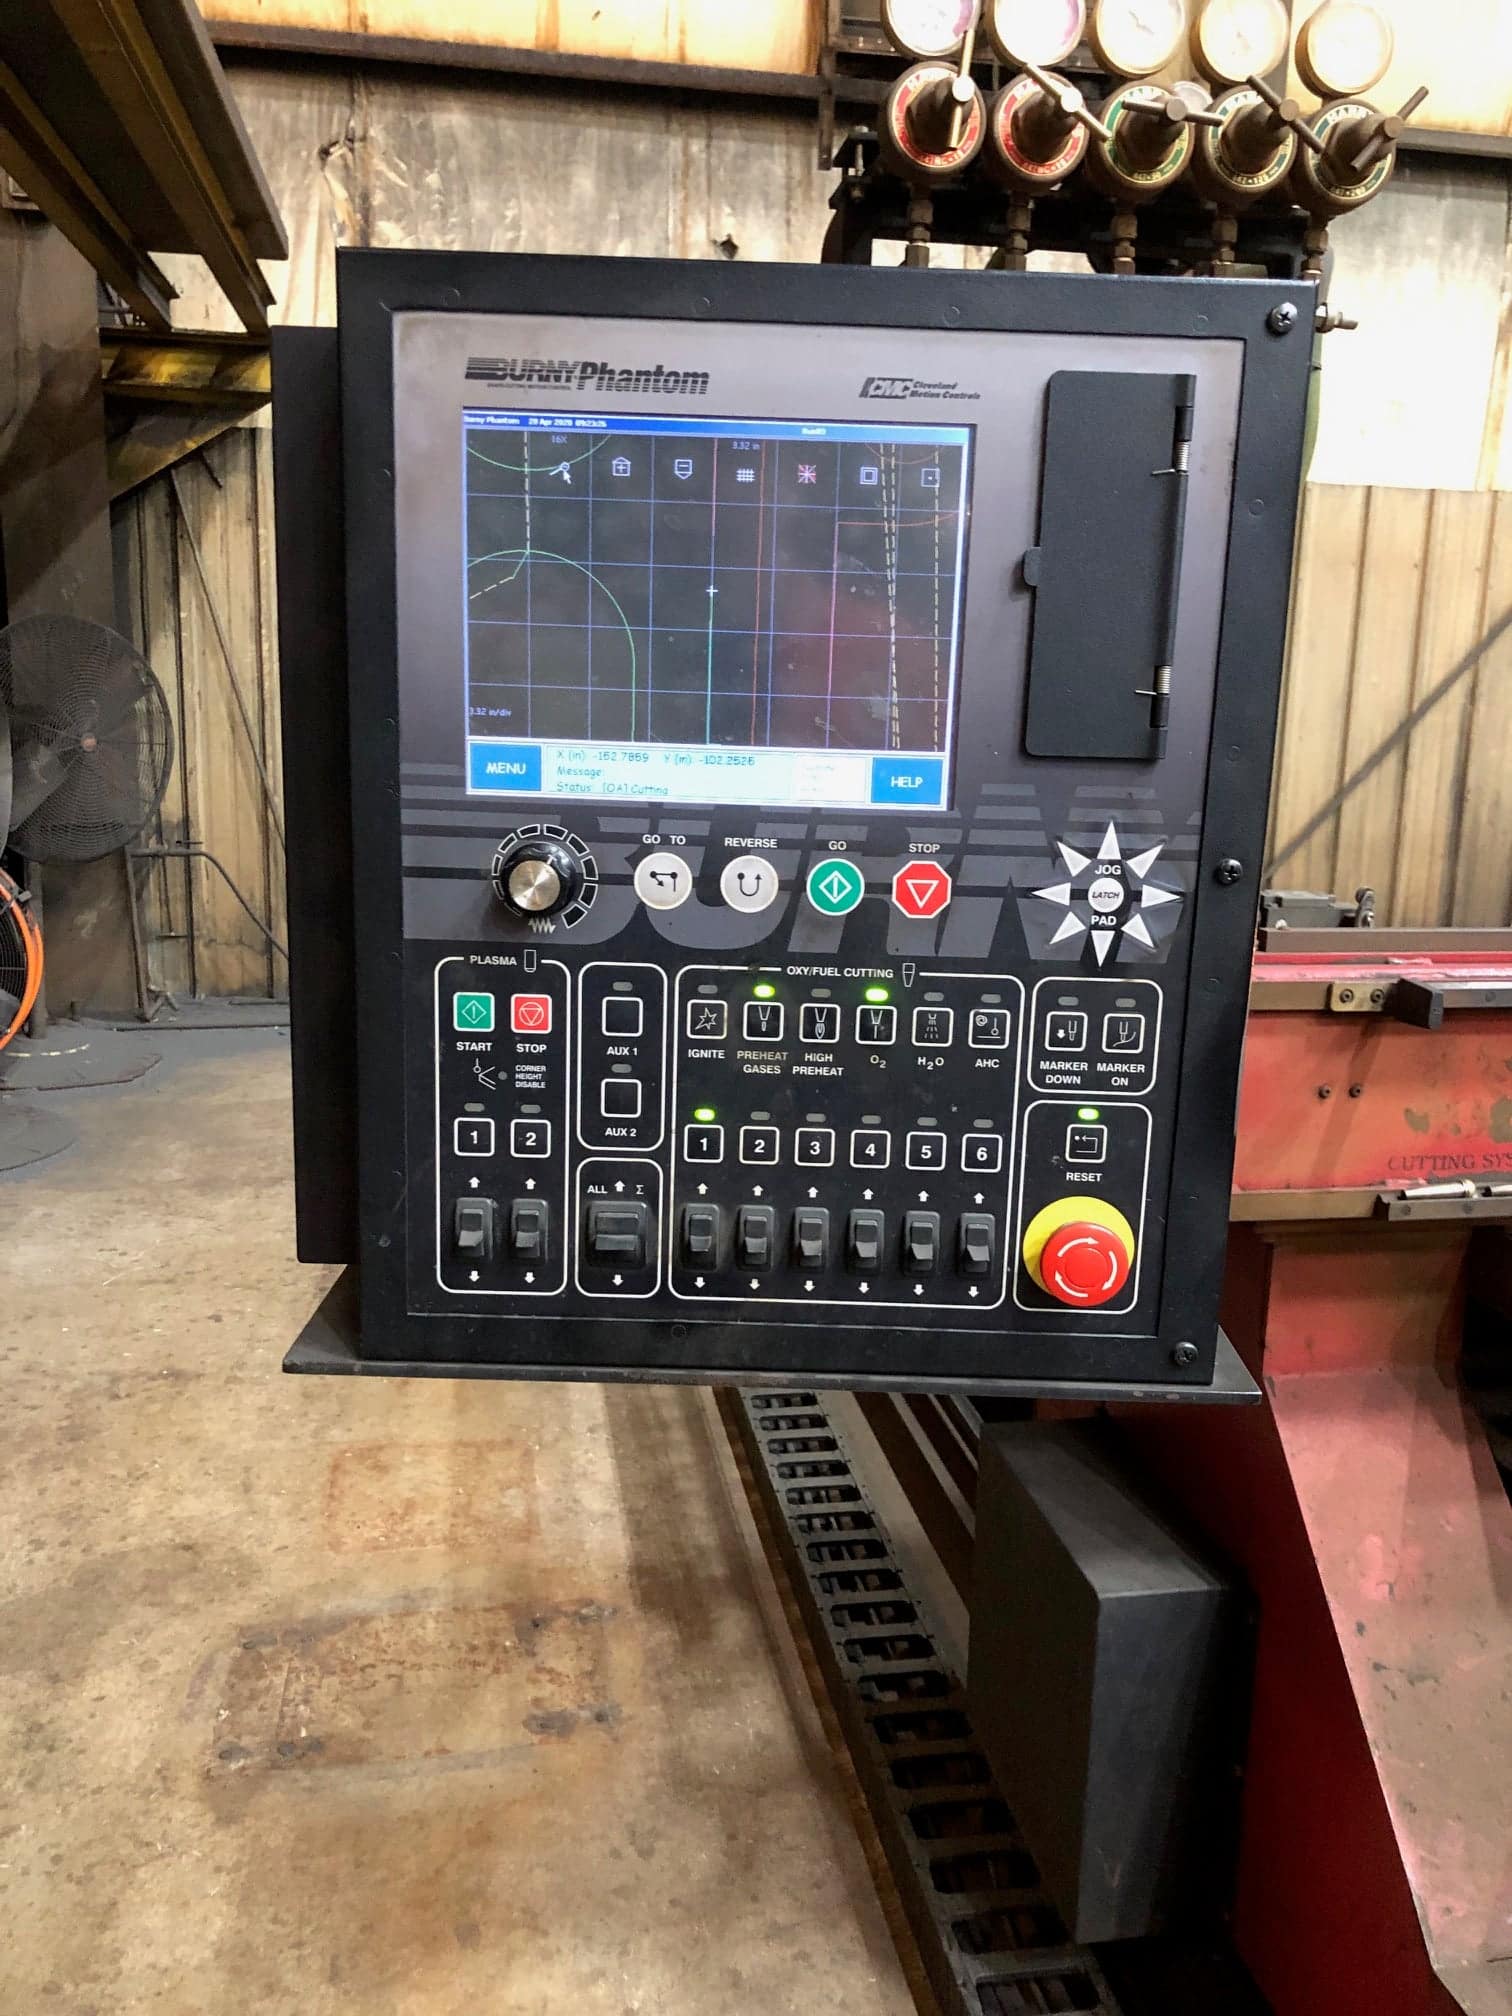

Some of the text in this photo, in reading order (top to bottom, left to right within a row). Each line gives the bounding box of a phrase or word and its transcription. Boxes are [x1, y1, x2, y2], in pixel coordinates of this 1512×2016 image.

[913, 381, 958, 390] Cleveland
[909, 390, 980, 400] Motion Controls
[486, 762, 526, 774] MENU
[891, 776, 923, 788] HELP
[631, 783, 668, 796] Cutting
[642, 834, 686, 845] GO TO
[724, 836, 778, 849] REVERSE
[828, 840, 847, 852] GO
[908, 843, 940, 854] STOP
[1094, 864, 1122, 875] JOG
[1091, 915, 1117, 926] PAD
[470, 955, 518, 966] PLASMA
[786, 965, 894, 978] OXY/FUEL CUTTING
[456, 1042, 492, 1052] START
[516, 1044, 547, 1054] STOP
[606, 1046, 638, 1056] AUX 1
[688, 1049, 726, 1059] IGNITE
[736, 1050, 788, 1061] PREHEAT
[804, 1052, 833, 1062] HIGH
[516, 1064, 546, 1072] CORNER
[975, 1058, 1000, 1068] AHC
[1040, 1061, 1088, 1071] MARKER
[1096, 1062, 1145, 1073] MARKER
[743, 1064, 781, 1074] GASES
[792, 1066, 844, 1076] PREHEAT
[1046, 1074, 1081, 1084] DOWN
[1112, 1076, 1128, 1086] ON
[470, 1131, 478, 1144] 1
[604, 1128, 637, 1137] AUX 2
[525, 1132, 537, 1146] 2
[700, 1138, 708, 1151] 1
[754, 1140, 766, 1153] 2
[810, 1142, 820, 1156] 3
[865, 1144, 876, 1156] 4
[921, 1146, 932, 1159] 5
[976, 1147, 988, 1161] 6
[1388, 1154, 1476, 1171] CUTTING
[1066, 1172, 1102, 1182] RESET
[587, 1185, 608, 1194] ALL
